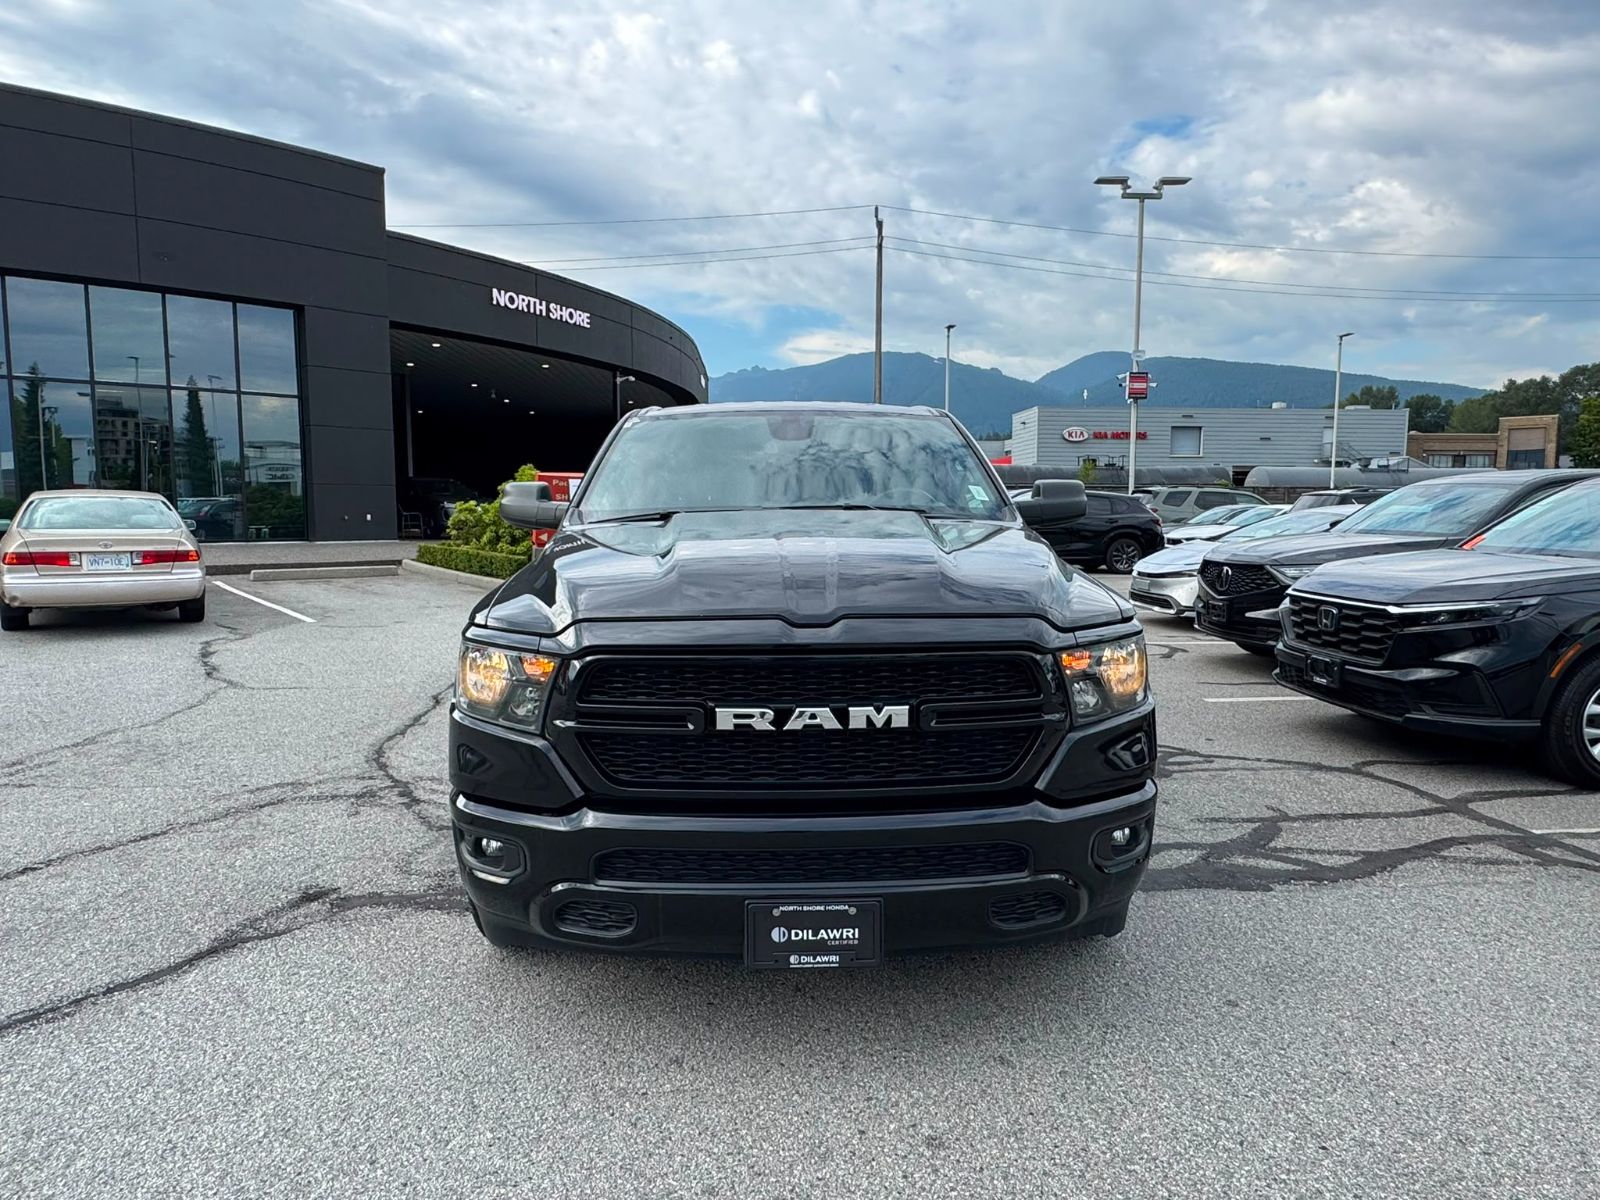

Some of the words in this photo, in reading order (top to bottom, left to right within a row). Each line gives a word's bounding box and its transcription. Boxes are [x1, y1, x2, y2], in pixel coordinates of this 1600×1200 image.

[492, 288, 547, 316] NORTH
[549, 303, 591, 328] SHORE
[1067, 429, 1085, 439] KIA
[1111, 431, 1148, 440] MOTRS
[715, 705, 910, 731] RAM
[791, 928, 859, 940] DILAWRI
[800, 955, 840, 964] DILAWRI
